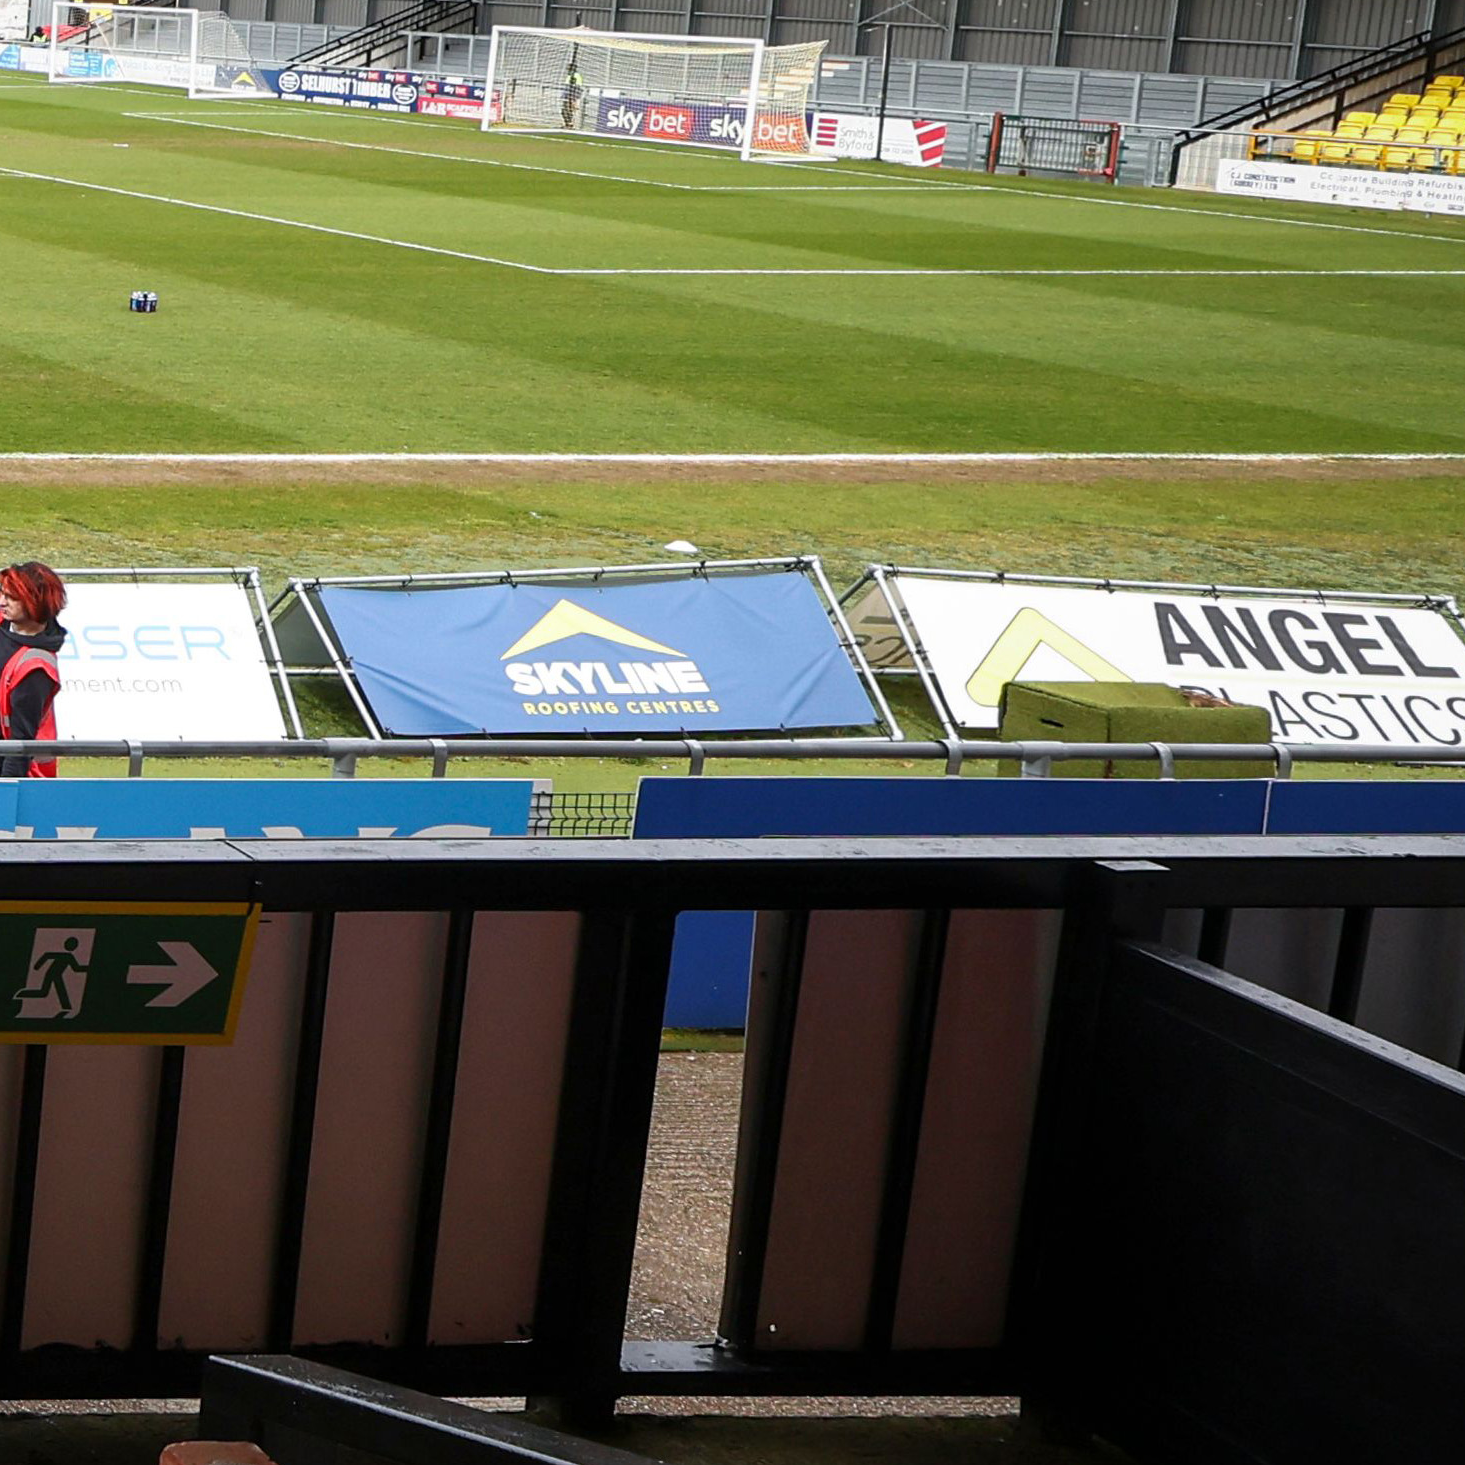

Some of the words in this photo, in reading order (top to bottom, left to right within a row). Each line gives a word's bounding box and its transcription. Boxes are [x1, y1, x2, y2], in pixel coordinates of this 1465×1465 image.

[301, 73, 351, 95] SELHURST
[353, 77, 391, 99] TIMBER
[607, 105, 643, 135] sky
[649, 109, 686, 135] bet
[710, 110, 745, 144] sky
[759, 114, 798, 144] bet
[840, 127, 867, 139] Smith
[838, 138, 874, 152] Byford
[1243, 173, 1296, 184] CONSTRUCTION
[1371, 176, 1414, 190] Building
[1365, 186, 1413, 200] Plumbing
[1154, 602, 1461, 678] ANGEL
[505, 661, 711, 696] SKYLINE
[523, 701, 620, 715] ROOFING
[626, 700, 721, 714] CENTRES
